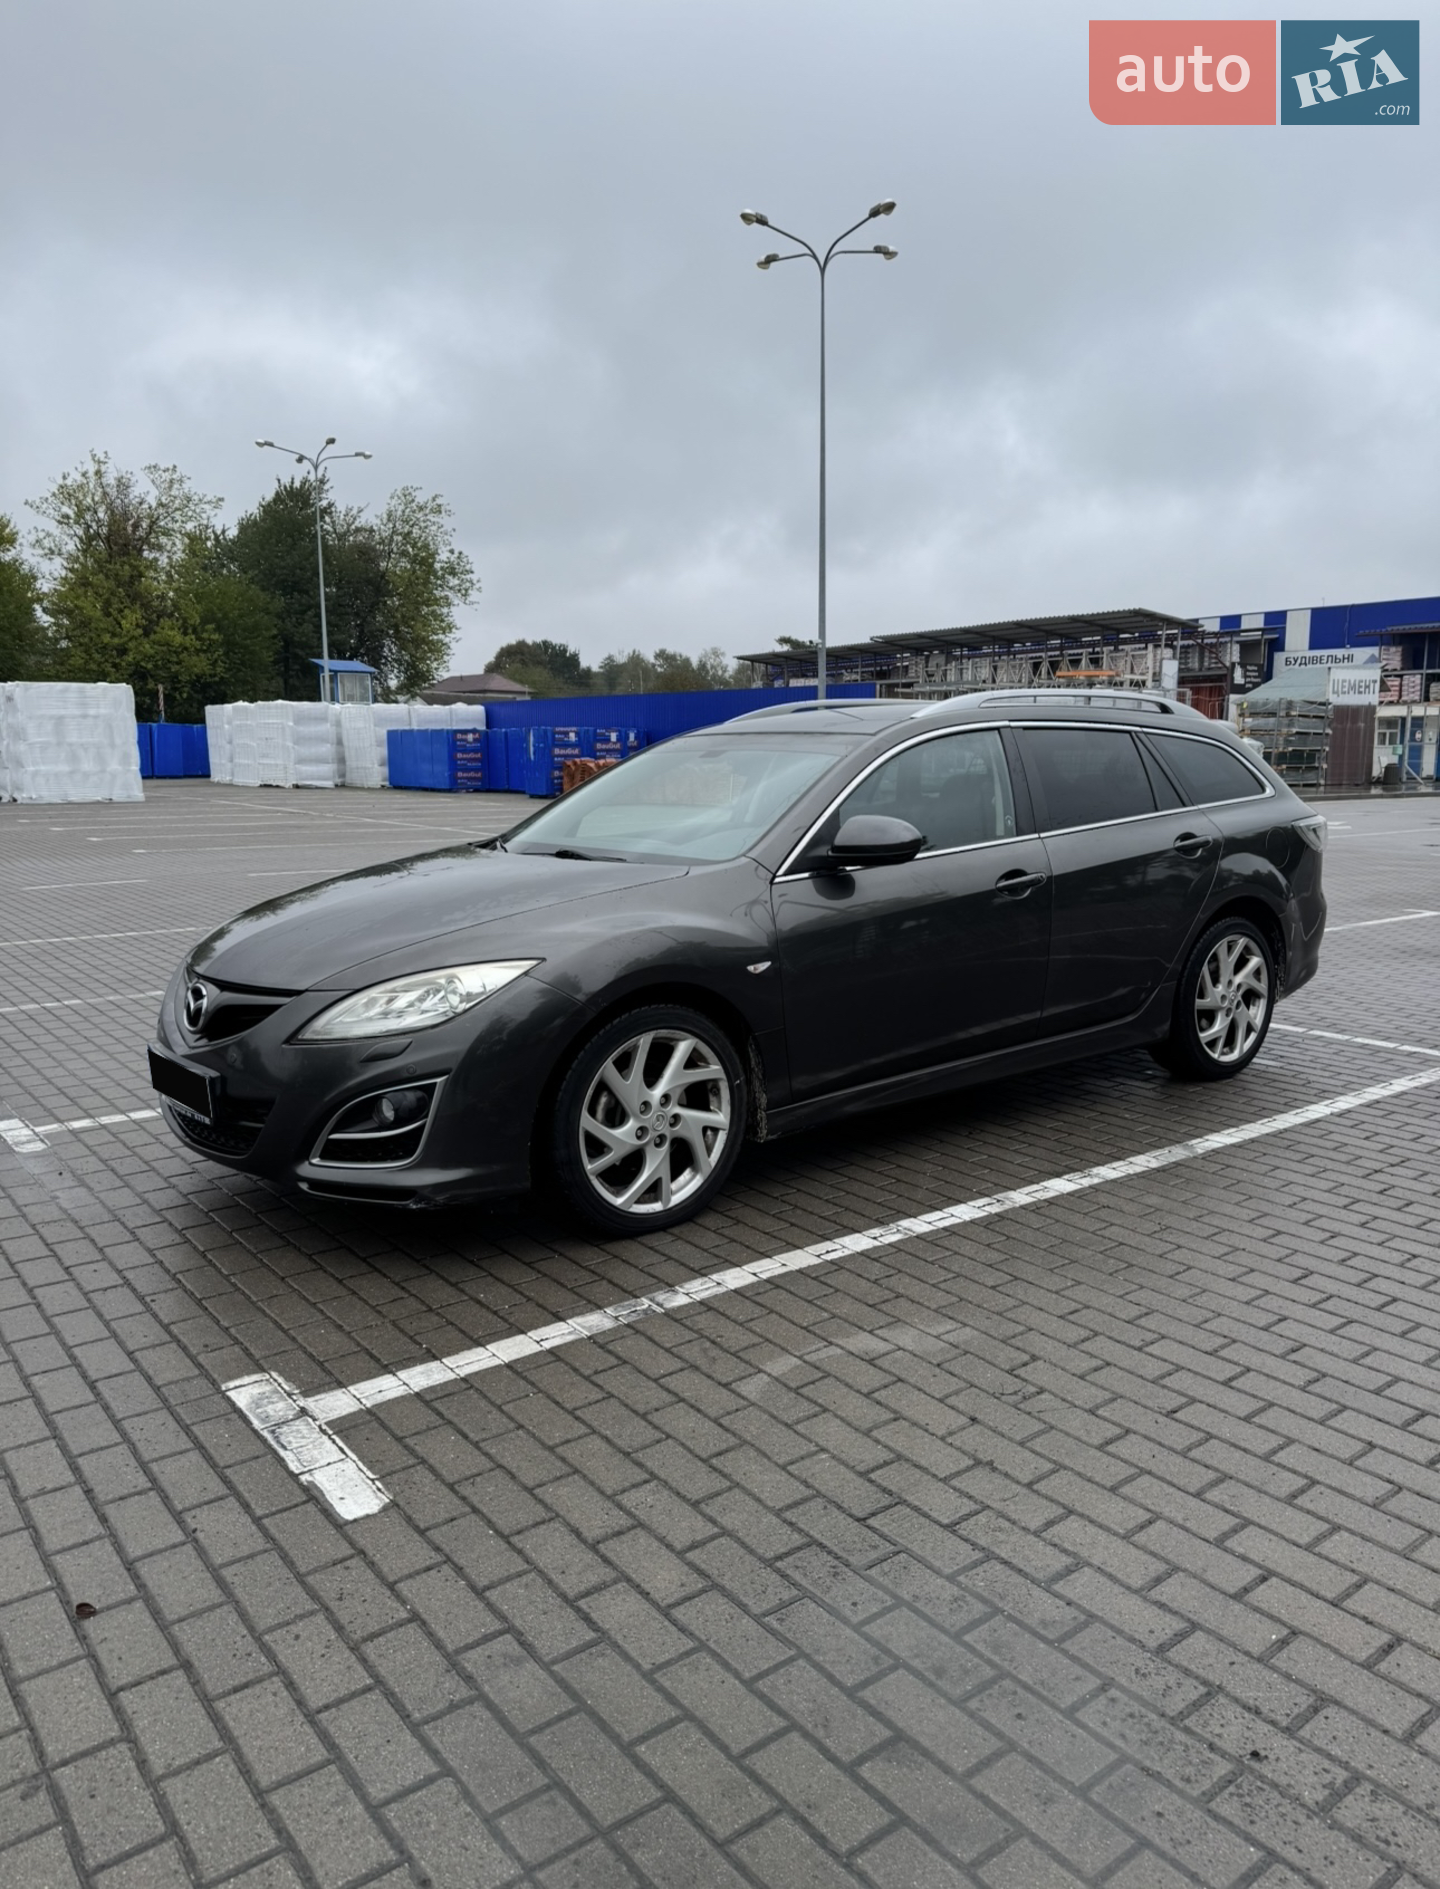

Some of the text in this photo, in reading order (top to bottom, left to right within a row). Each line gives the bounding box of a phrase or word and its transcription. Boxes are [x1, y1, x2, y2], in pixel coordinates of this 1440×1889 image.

[1284, 653, 1354, 667] БУДІВЕЛЬНІ
[1331, 678, 1378, 697] ЦЕМЕНТ
[554, 747, 579, 755] BauGut
